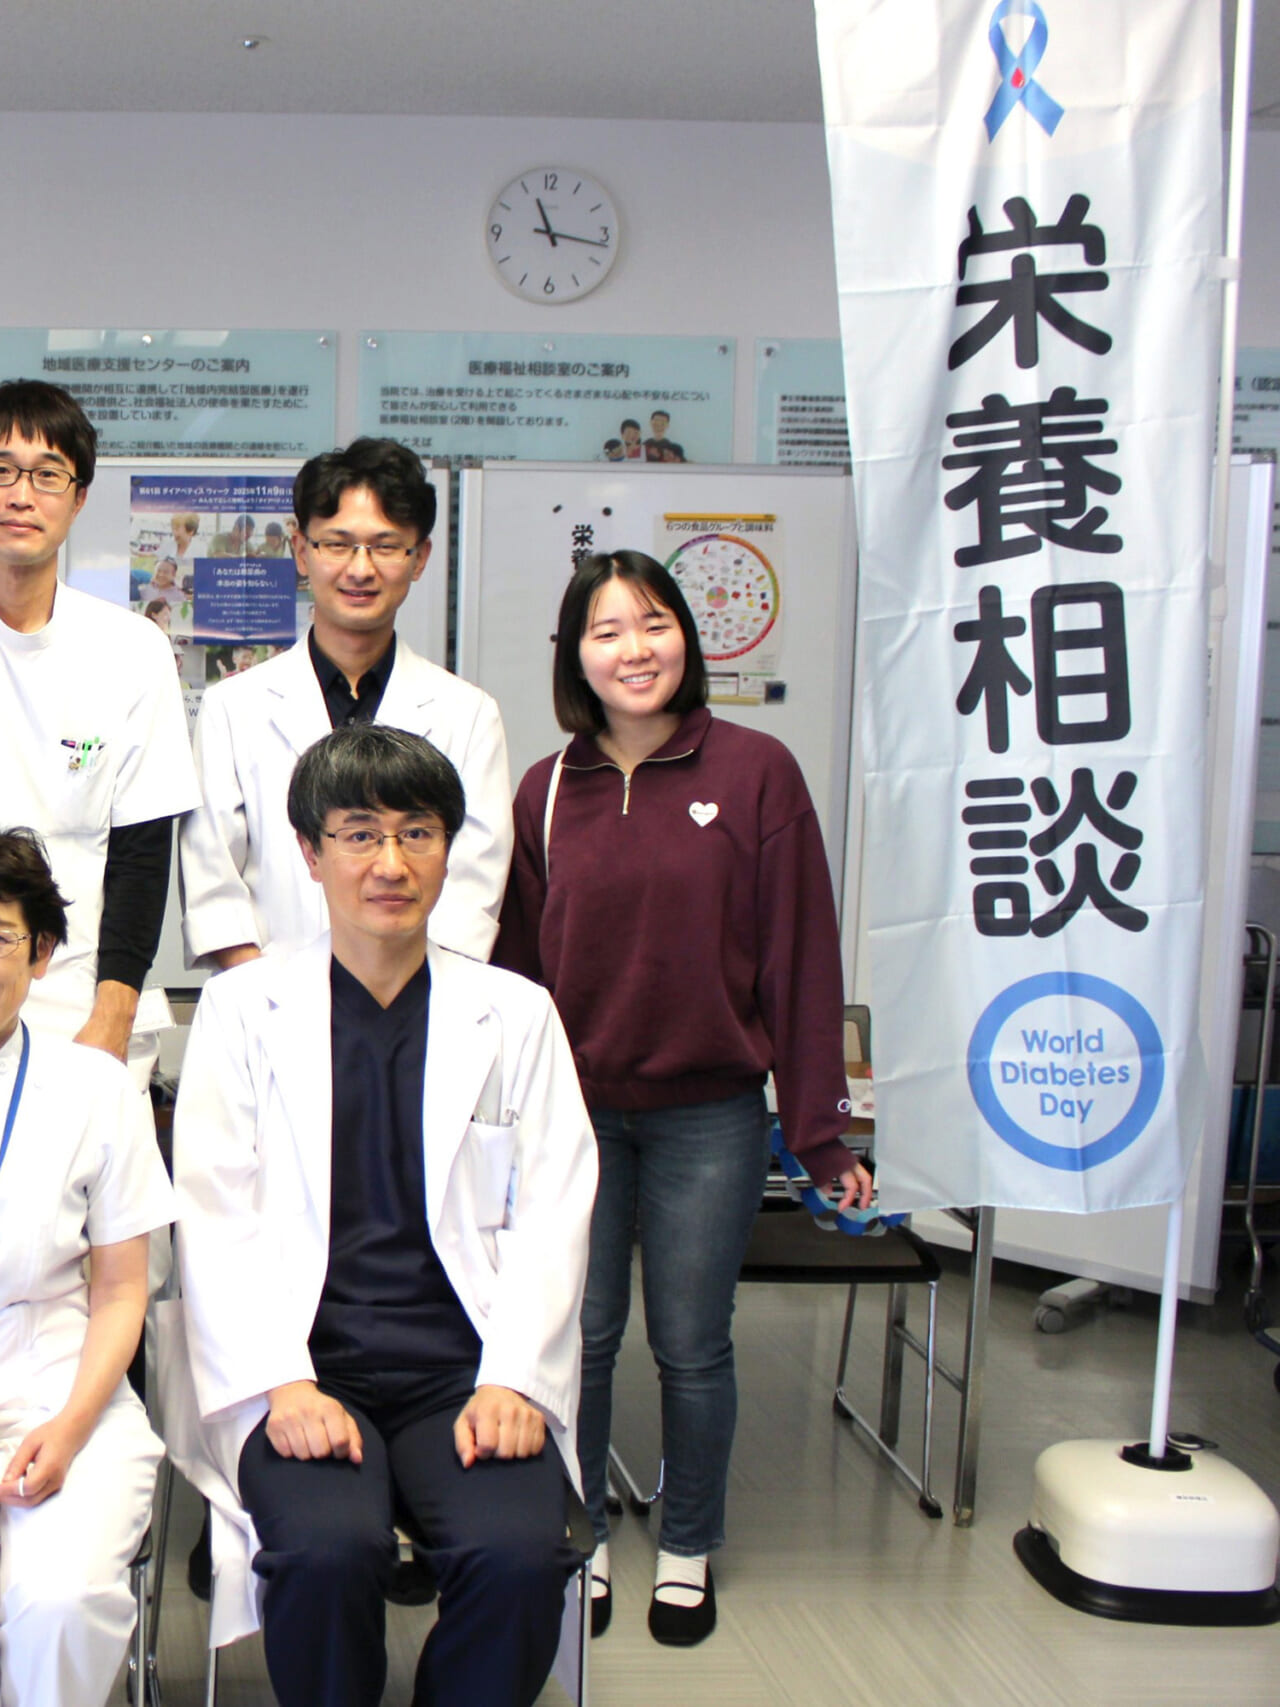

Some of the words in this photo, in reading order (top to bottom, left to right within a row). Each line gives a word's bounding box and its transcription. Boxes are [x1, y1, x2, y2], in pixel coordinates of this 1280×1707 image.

[544, 173, 558, 191] 12
[490, 224, 502, 243] 9
[599, 226, 610, 243] 3
[543, 276, 555, 294] 6
[42, 356, 250, 374] 地域医療支援センターのご案内
[469, 360, 630, 378] 医療福祉相談室のご案内
[399, 436, 433, 448] とえば
[162, 487, 204, 496] ダイアベティス
[207, 487, 229, 496] ウィーク
[666, 521, 774, 532] 6つの食品グループと調味料
[943, 195, 1147, 937] 栄養相談
[1021, 1028, 1105, 1054] World
[1000, 1061, 1131, 1086] Diabetes
[1039, 1092, 1094, 1124] Day
